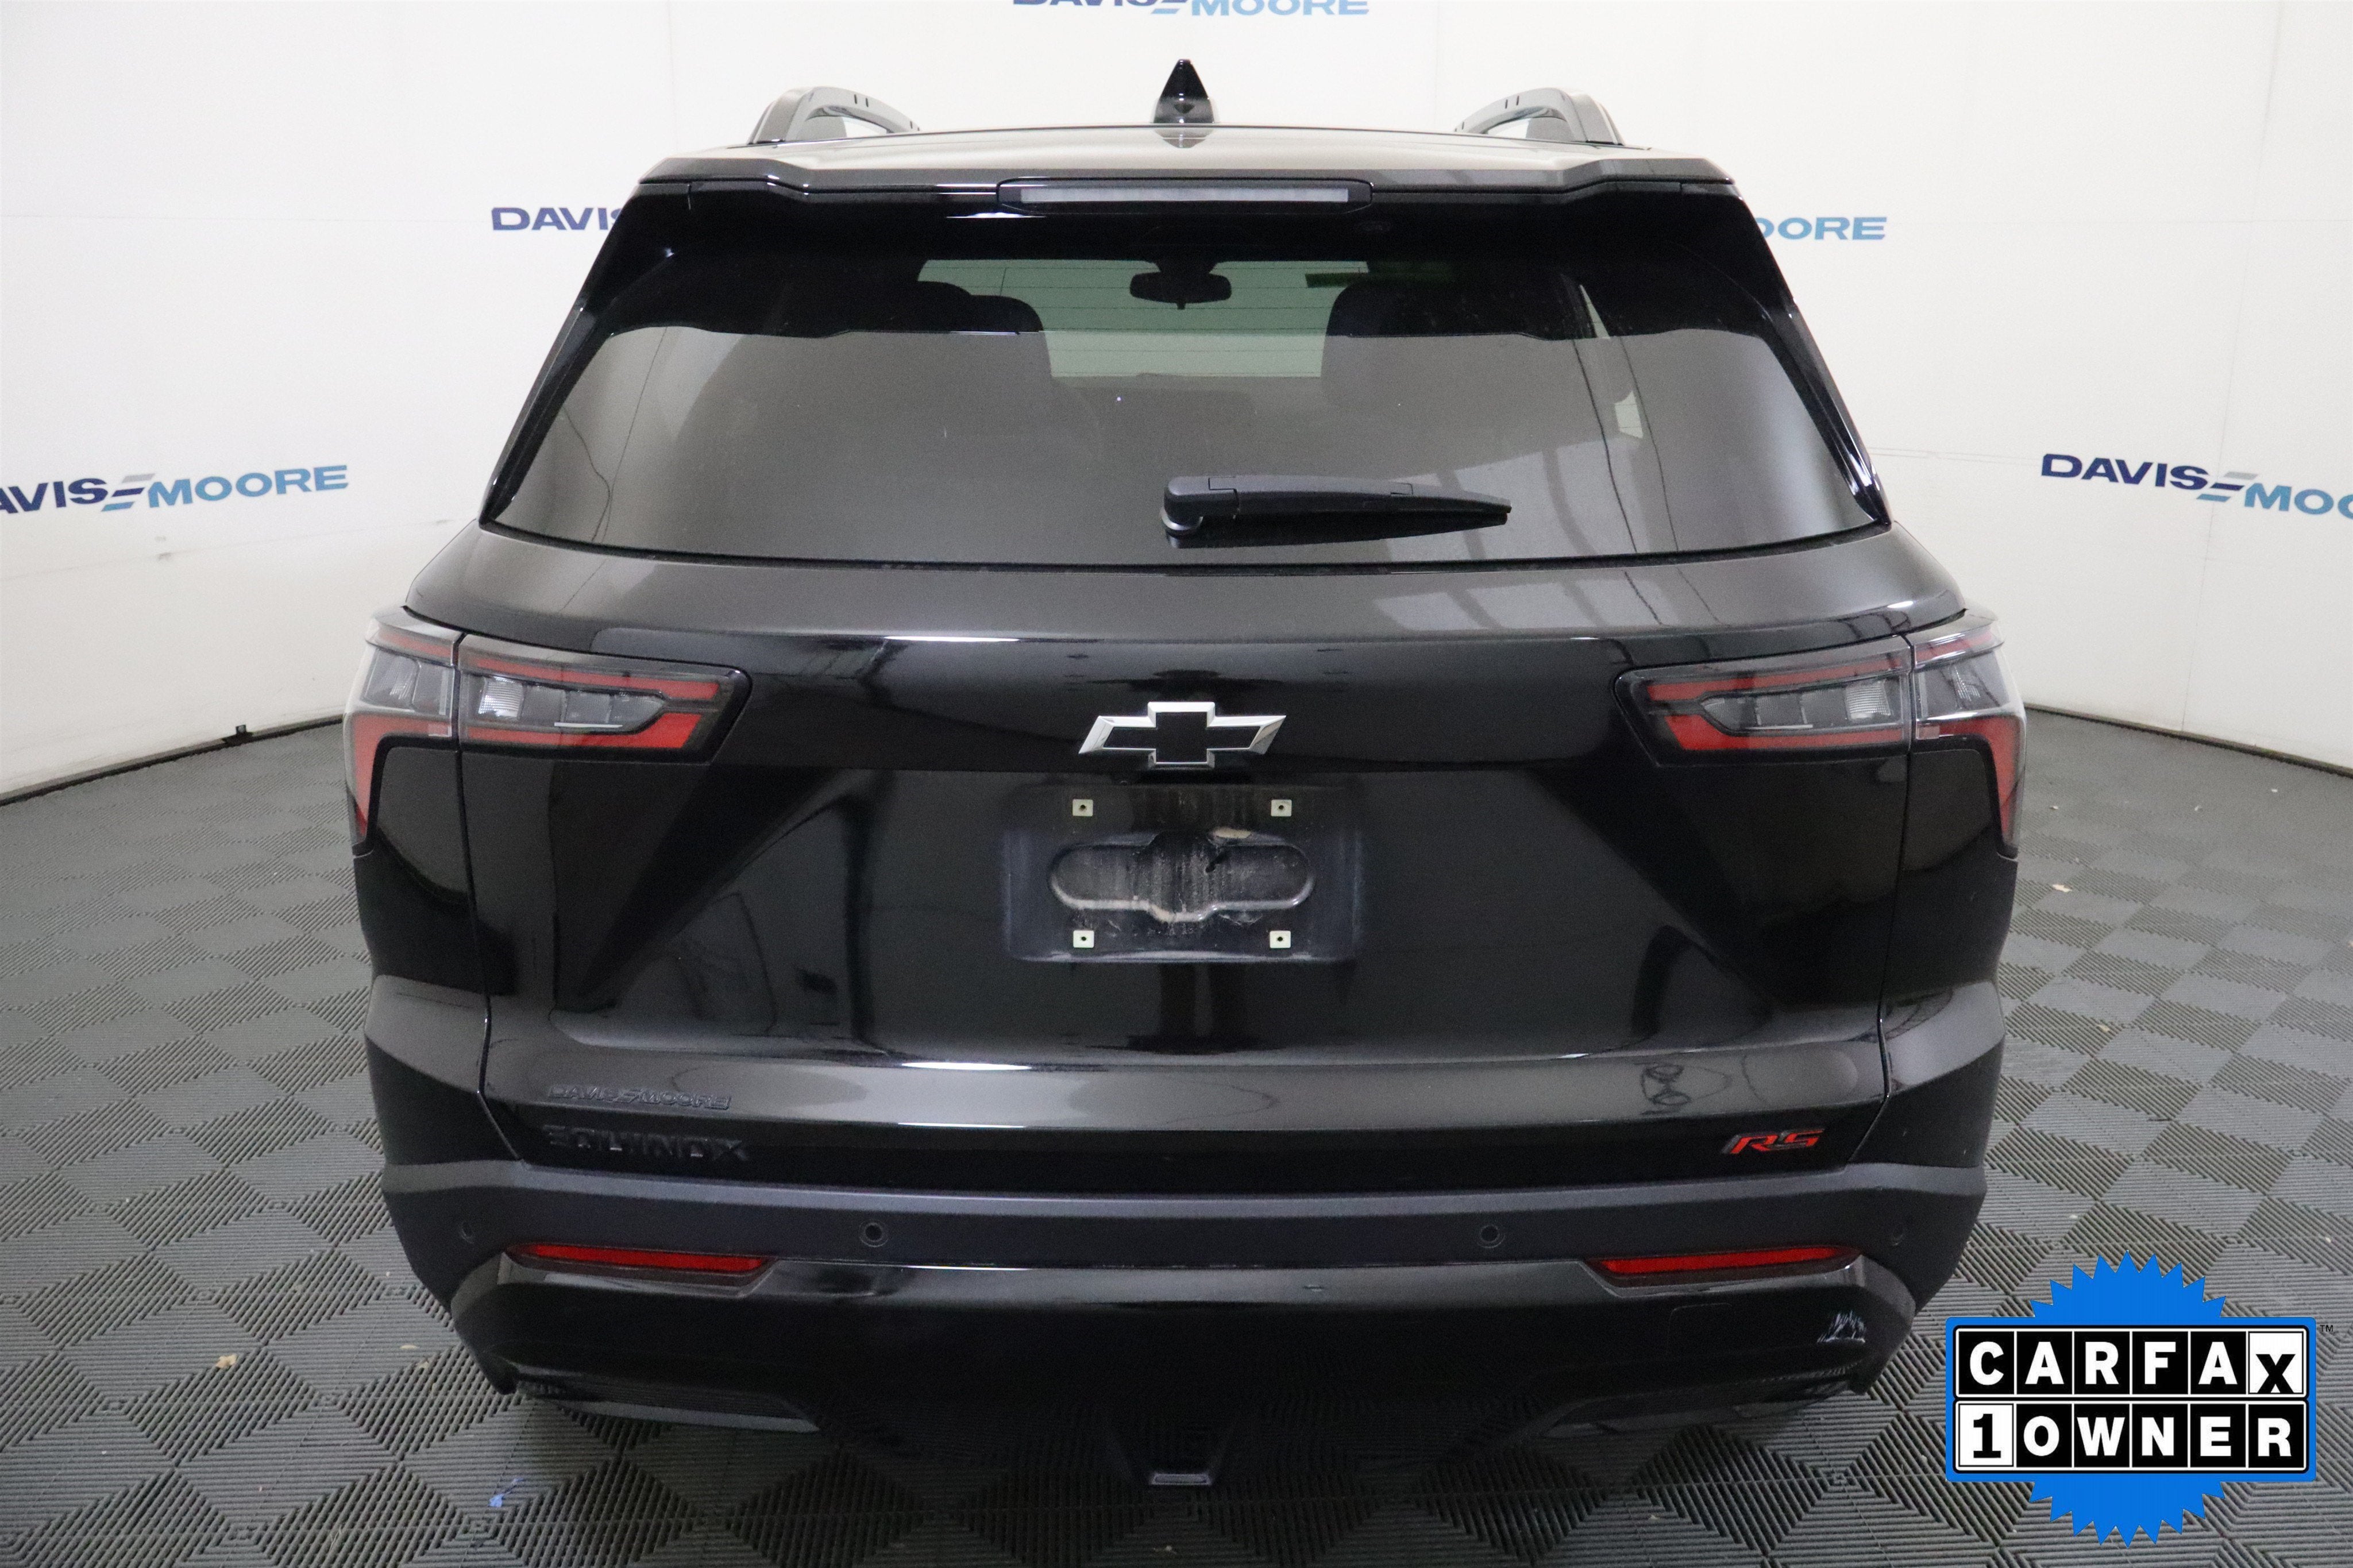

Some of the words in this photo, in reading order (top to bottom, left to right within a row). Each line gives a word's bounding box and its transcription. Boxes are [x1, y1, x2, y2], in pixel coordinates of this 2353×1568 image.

[1191, 0, 1370, 16] MOORE
[148, 465, 349, 508] MOORE
[2041, 454, 2209, 491] DAVIS
[638, 1090, 732, 1110] MOORE
[543, 1124, 747, 1161] EQUINOX
[1723, 1129, 1825, 1154] RS
